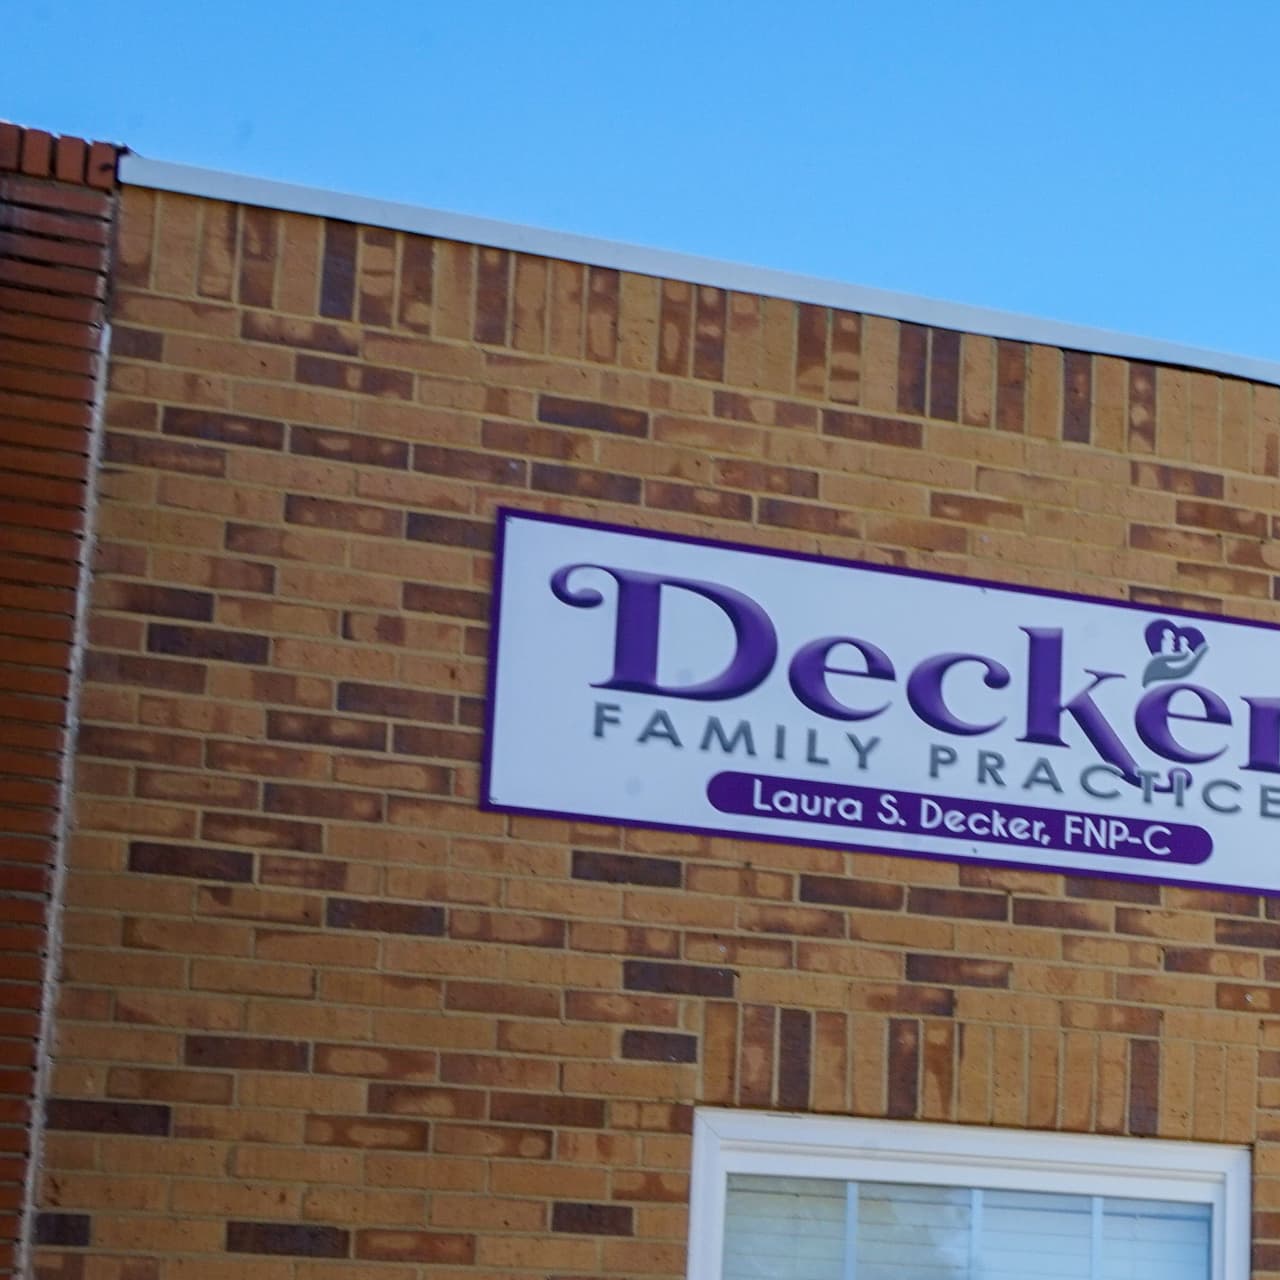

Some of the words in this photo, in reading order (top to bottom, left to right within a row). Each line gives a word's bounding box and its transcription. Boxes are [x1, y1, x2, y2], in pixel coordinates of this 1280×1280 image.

[591, 701, 884, 770] FAMILY
[752, 779, 862, 820] Laura
[877, 794, 906, 826] S.
[920, 799, 1051, 845] Decker,
[1063, 815, 1172, 856] FNP-C
